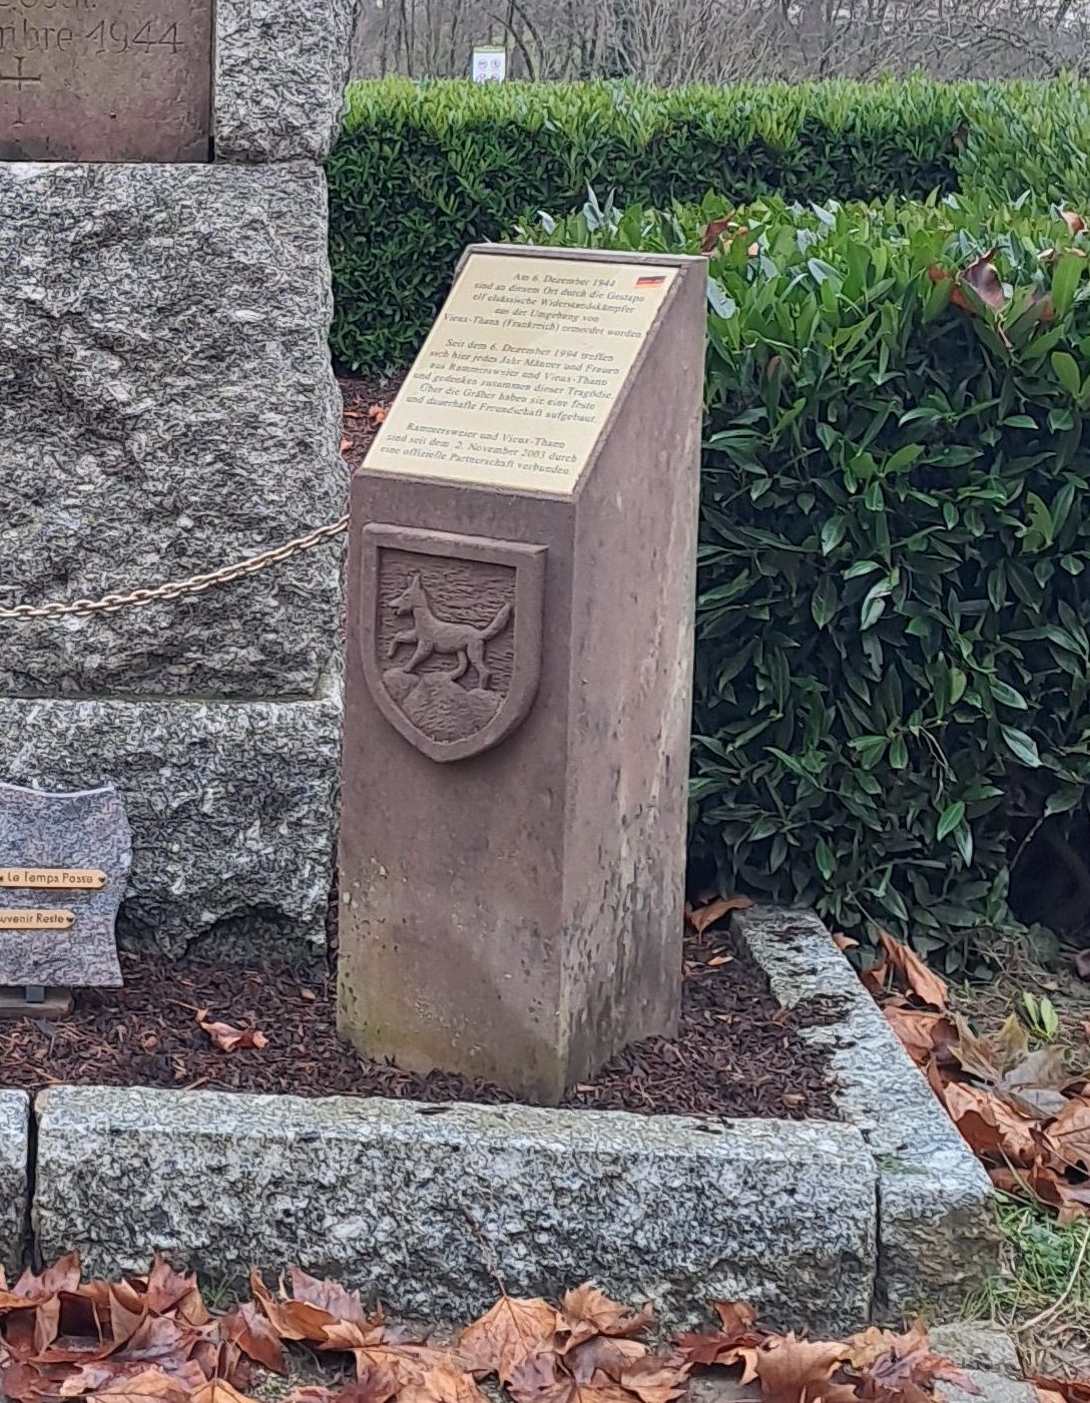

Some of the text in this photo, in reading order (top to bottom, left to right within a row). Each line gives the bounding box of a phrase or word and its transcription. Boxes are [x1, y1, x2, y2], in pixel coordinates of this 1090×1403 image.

[86, 20, 184, 55] 1944
[8, 872, 20, 883] Le
[62, 872, 94, 884] Passe
[36, 913, 65, 925] Reste
